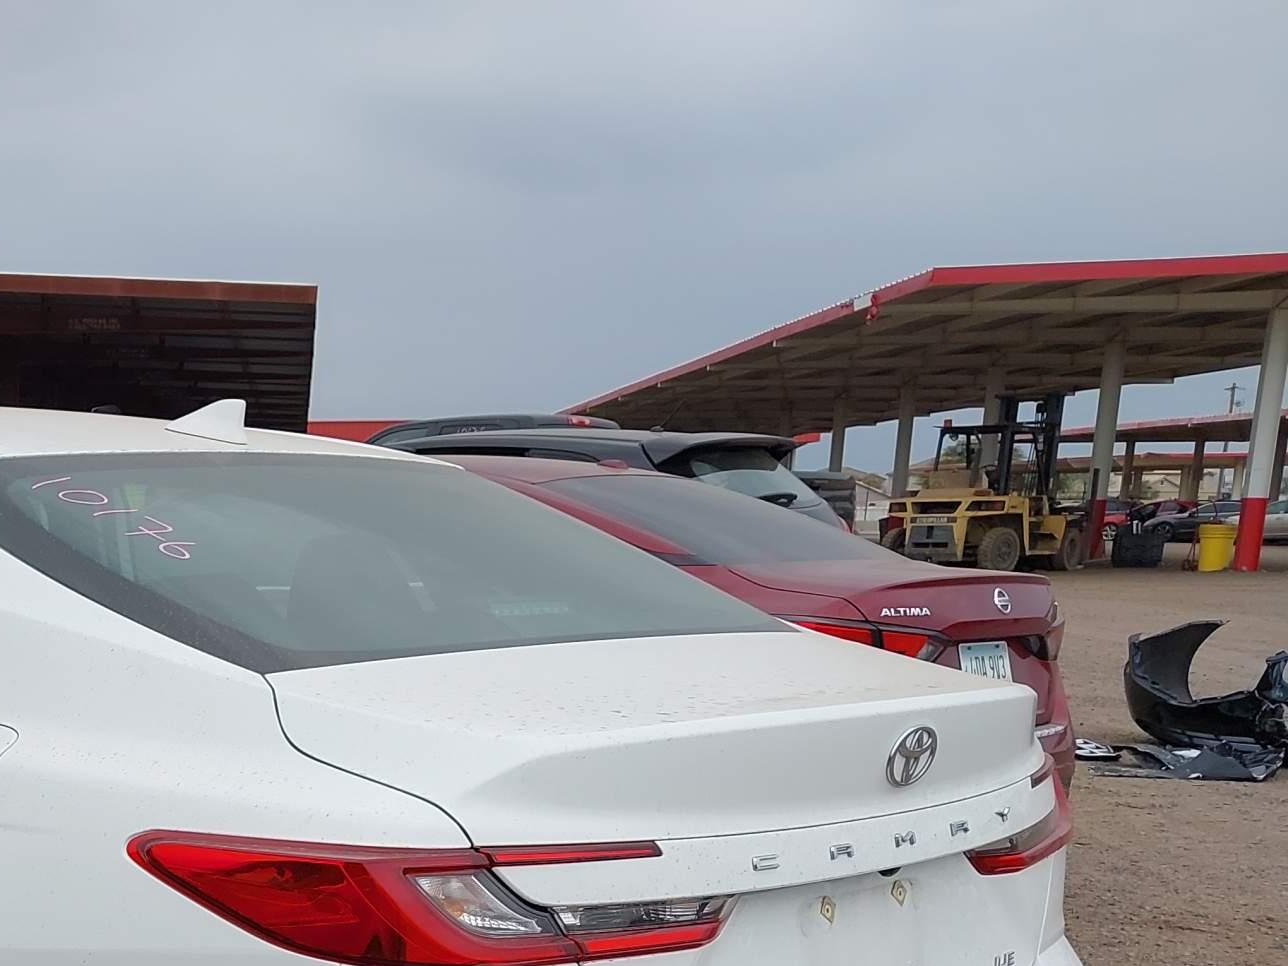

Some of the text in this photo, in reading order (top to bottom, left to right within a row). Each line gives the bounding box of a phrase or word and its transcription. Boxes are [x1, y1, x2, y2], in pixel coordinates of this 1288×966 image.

[31, 476, 197, 560] 10176
[880, 607, 931, 617] ALTIMA
[751, 806, 1011, 872] CAMRY
